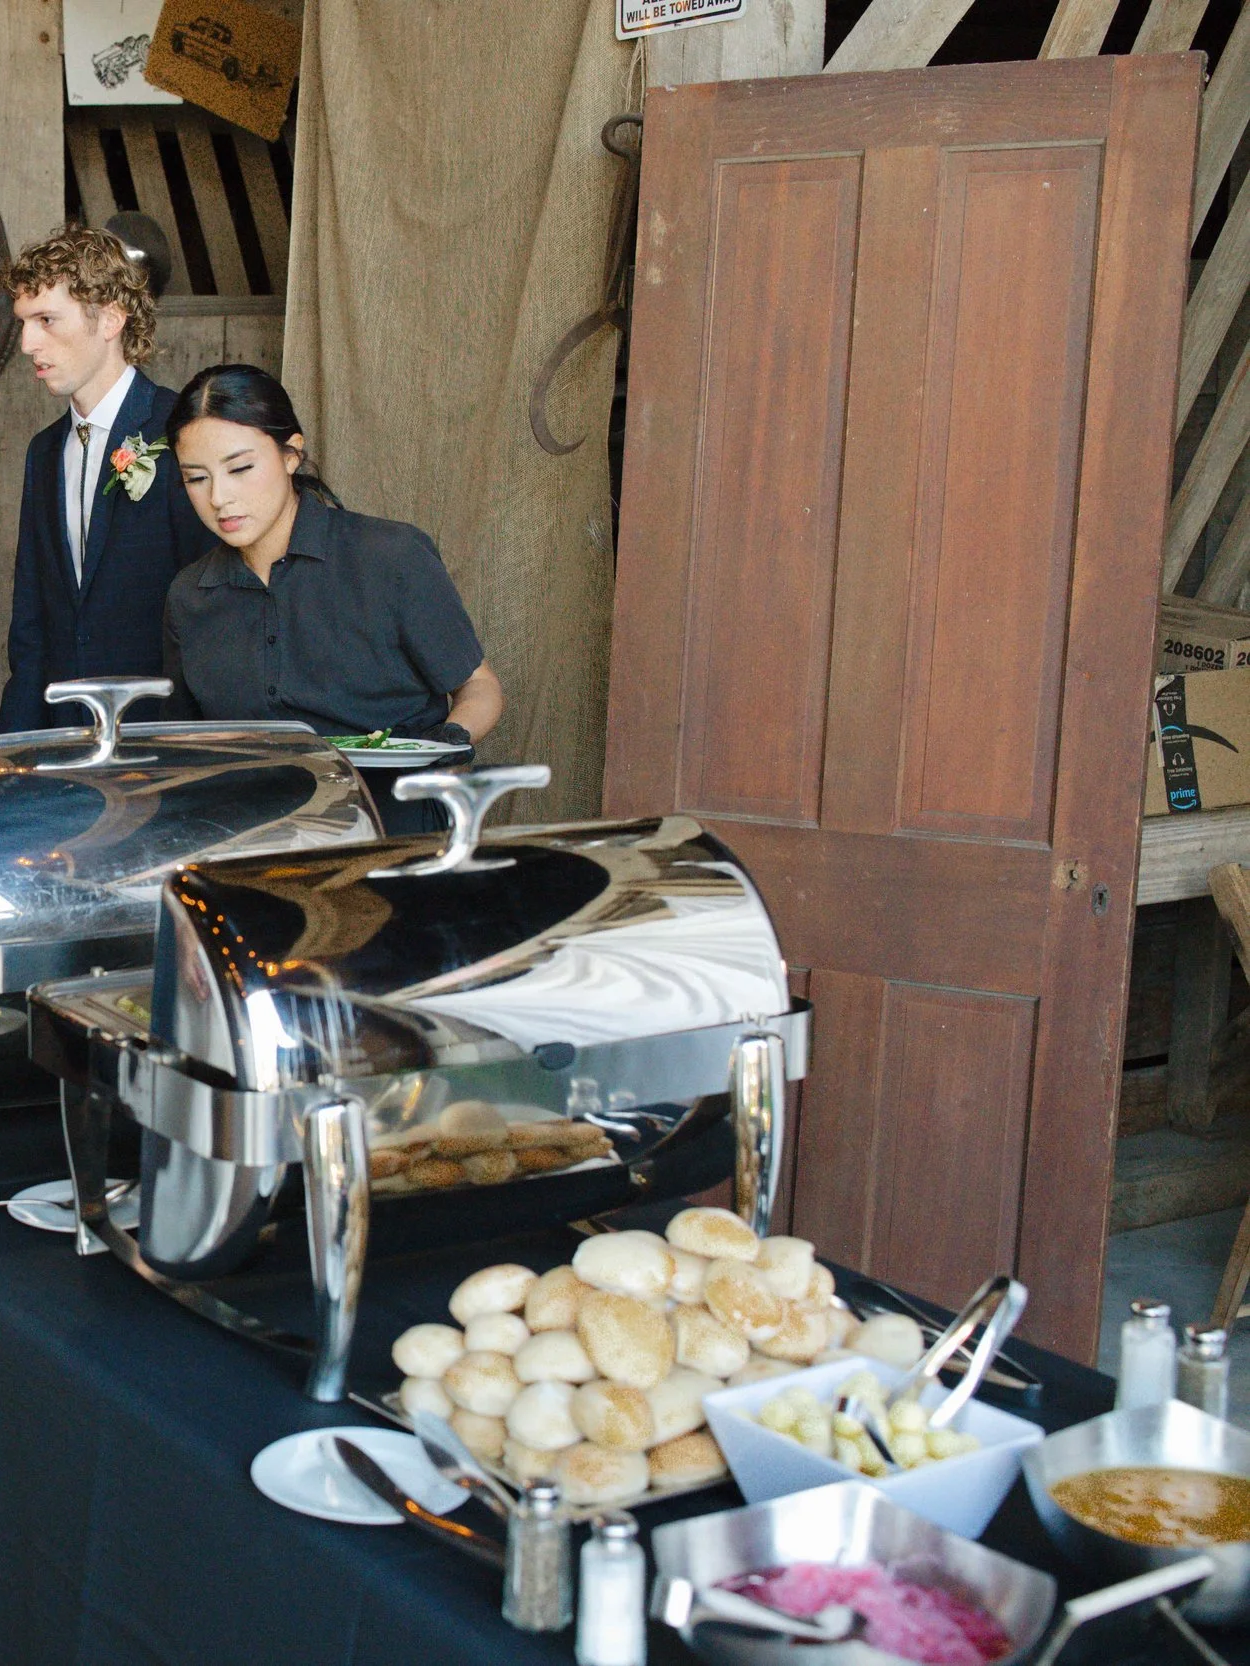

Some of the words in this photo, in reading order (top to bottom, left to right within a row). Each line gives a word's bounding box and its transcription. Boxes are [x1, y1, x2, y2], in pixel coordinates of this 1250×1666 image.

[626, 9, 650, 23] WILL
[653, 5, 666, 18] BE
[669, 0, 705, 15] TOWED
[1163, 639, 1225, 664] 208602
[1170, 787, 1196, 802] prime
